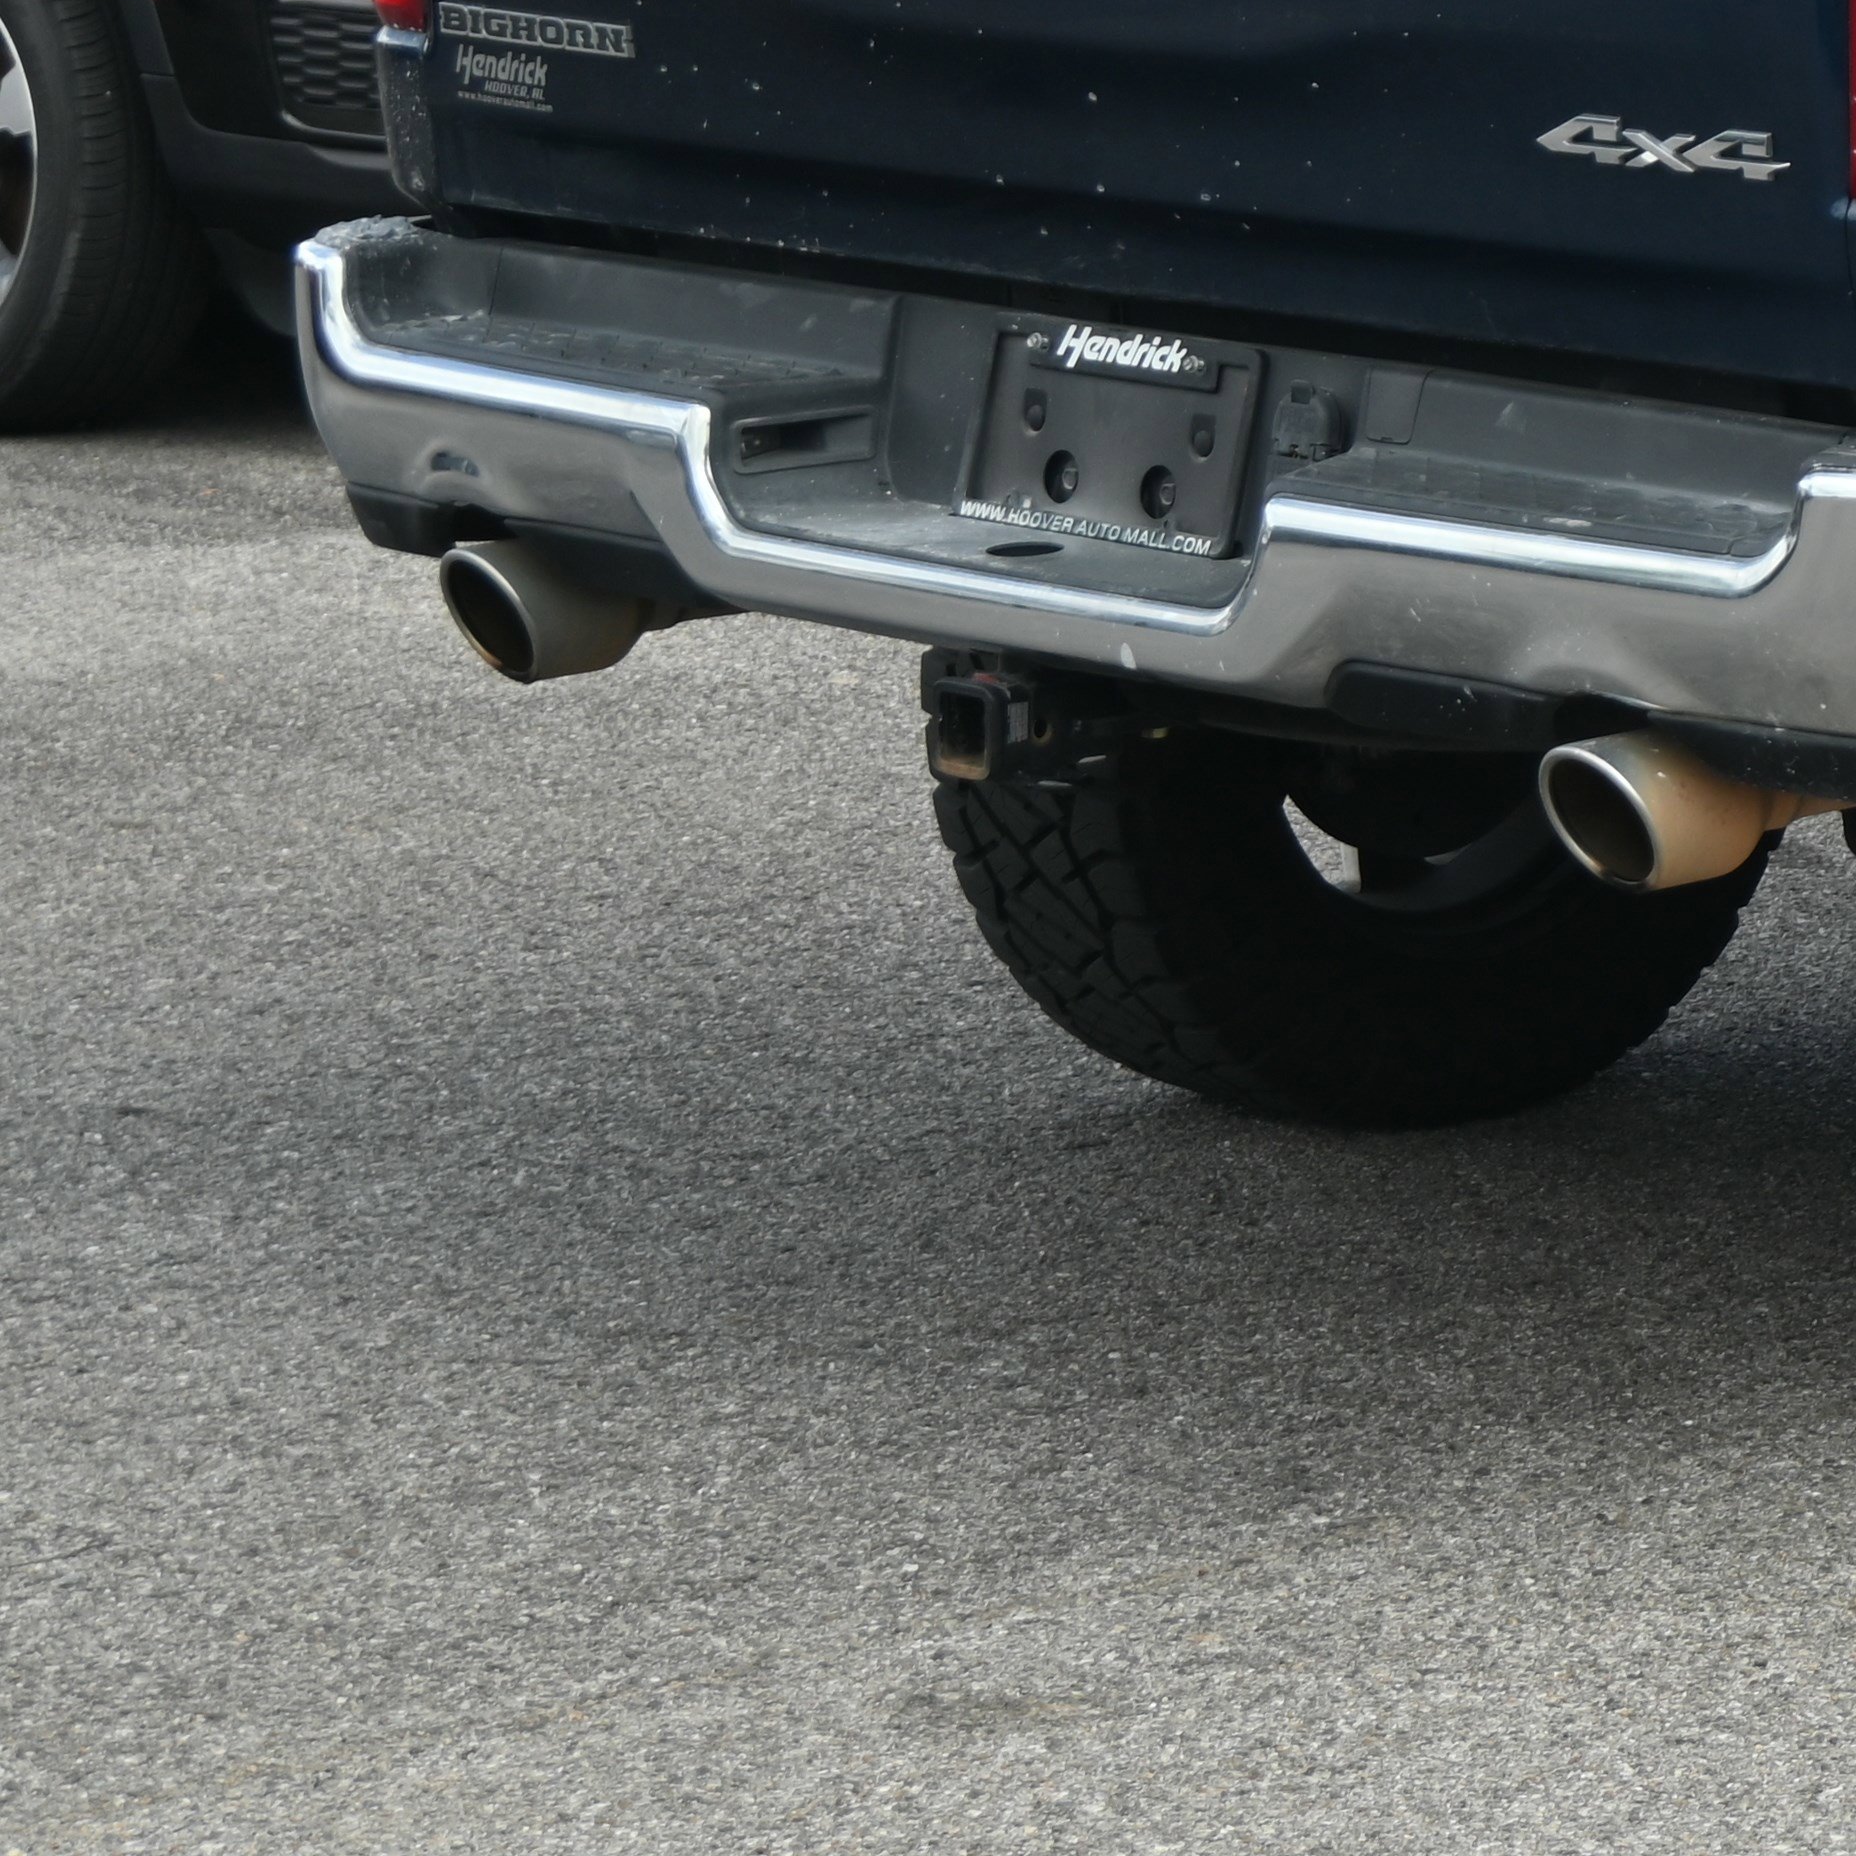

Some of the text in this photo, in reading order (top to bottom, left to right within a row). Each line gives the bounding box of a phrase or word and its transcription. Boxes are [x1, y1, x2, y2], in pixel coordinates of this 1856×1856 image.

[438, 1, 636, 58] BIGHORN
[456, 43, 548, 86] Hendrick
[1056, 323, 1189, 374] Hendrick
[1075, 519, 1123, 542] AUTO
